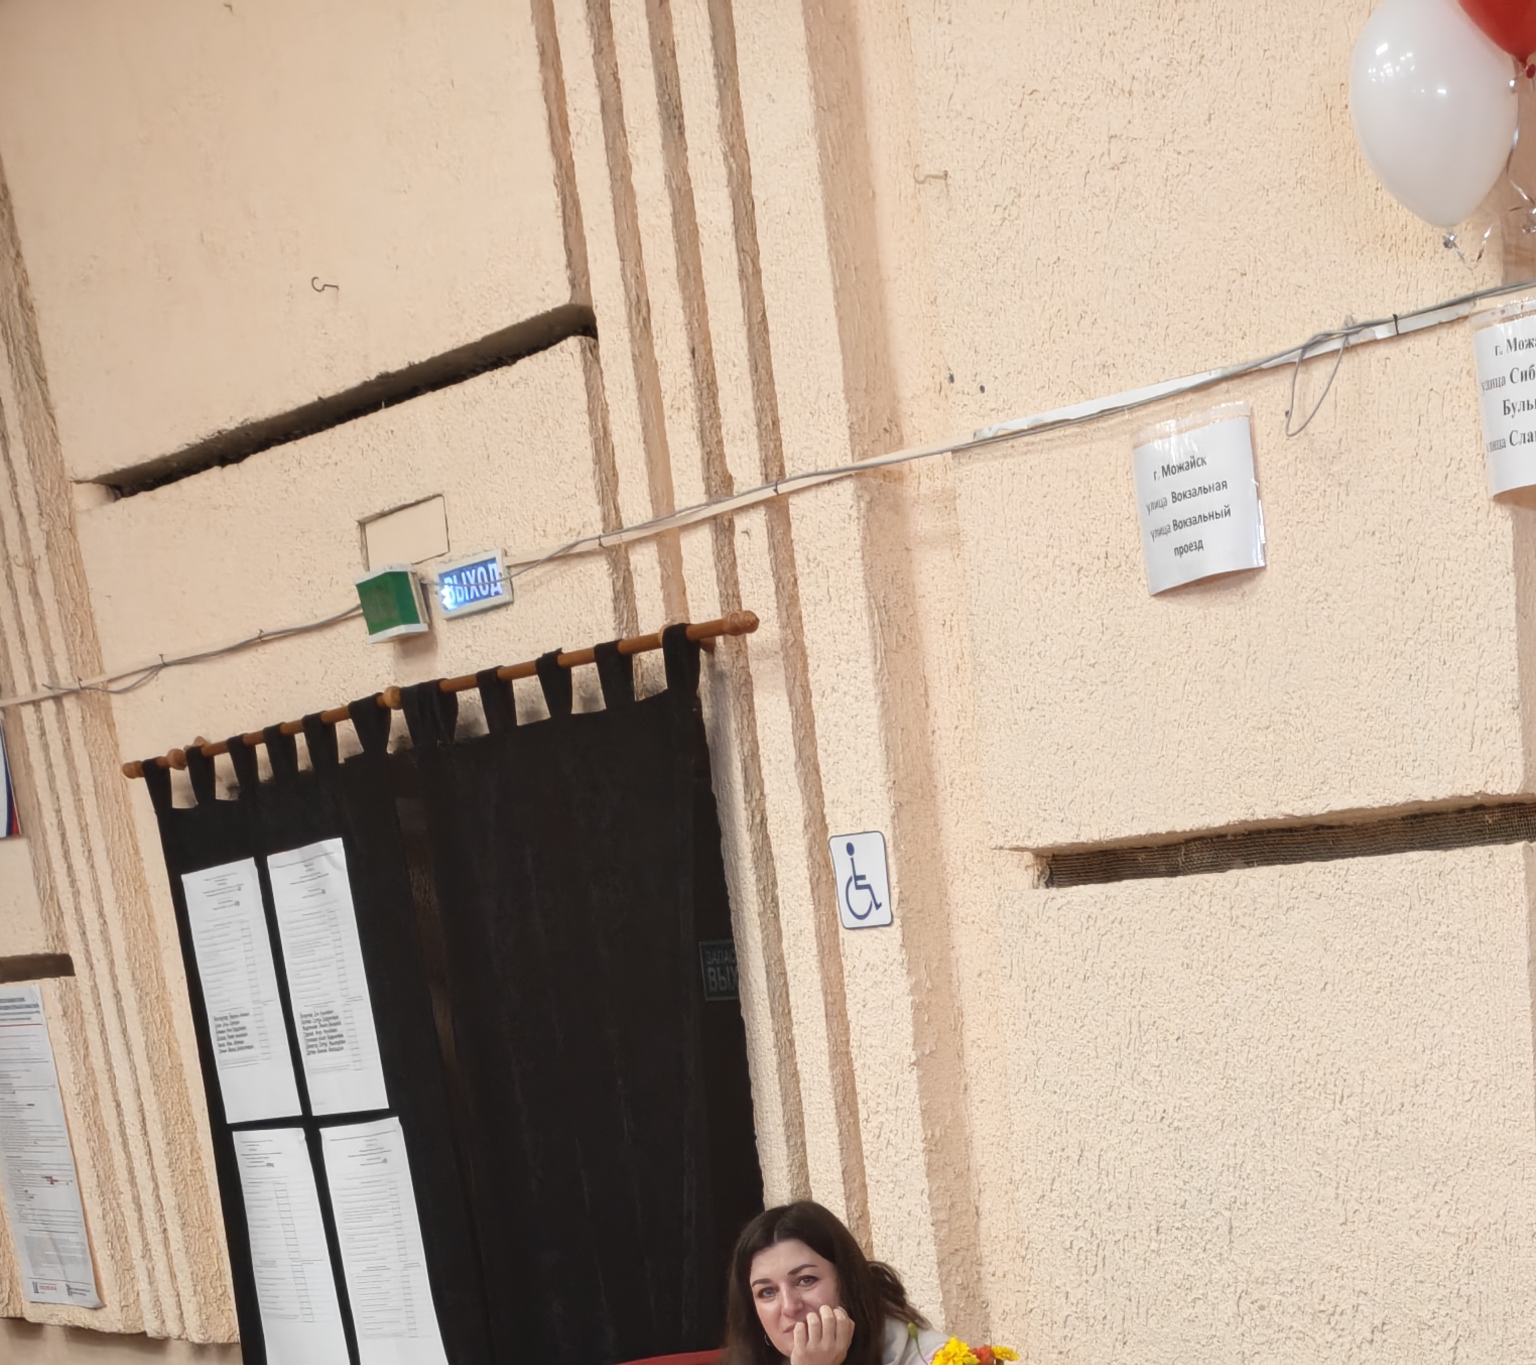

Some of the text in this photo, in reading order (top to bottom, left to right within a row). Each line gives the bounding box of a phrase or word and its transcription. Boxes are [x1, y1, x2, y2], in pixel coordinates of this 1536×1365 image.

[1161, 454, 1207, 479] Можайск
[1171, 479, 1228, 503] Вокзальная
[1172, 503, 1232, 532] Вокзальный
[1173, 539, 1204, 558] проезд
